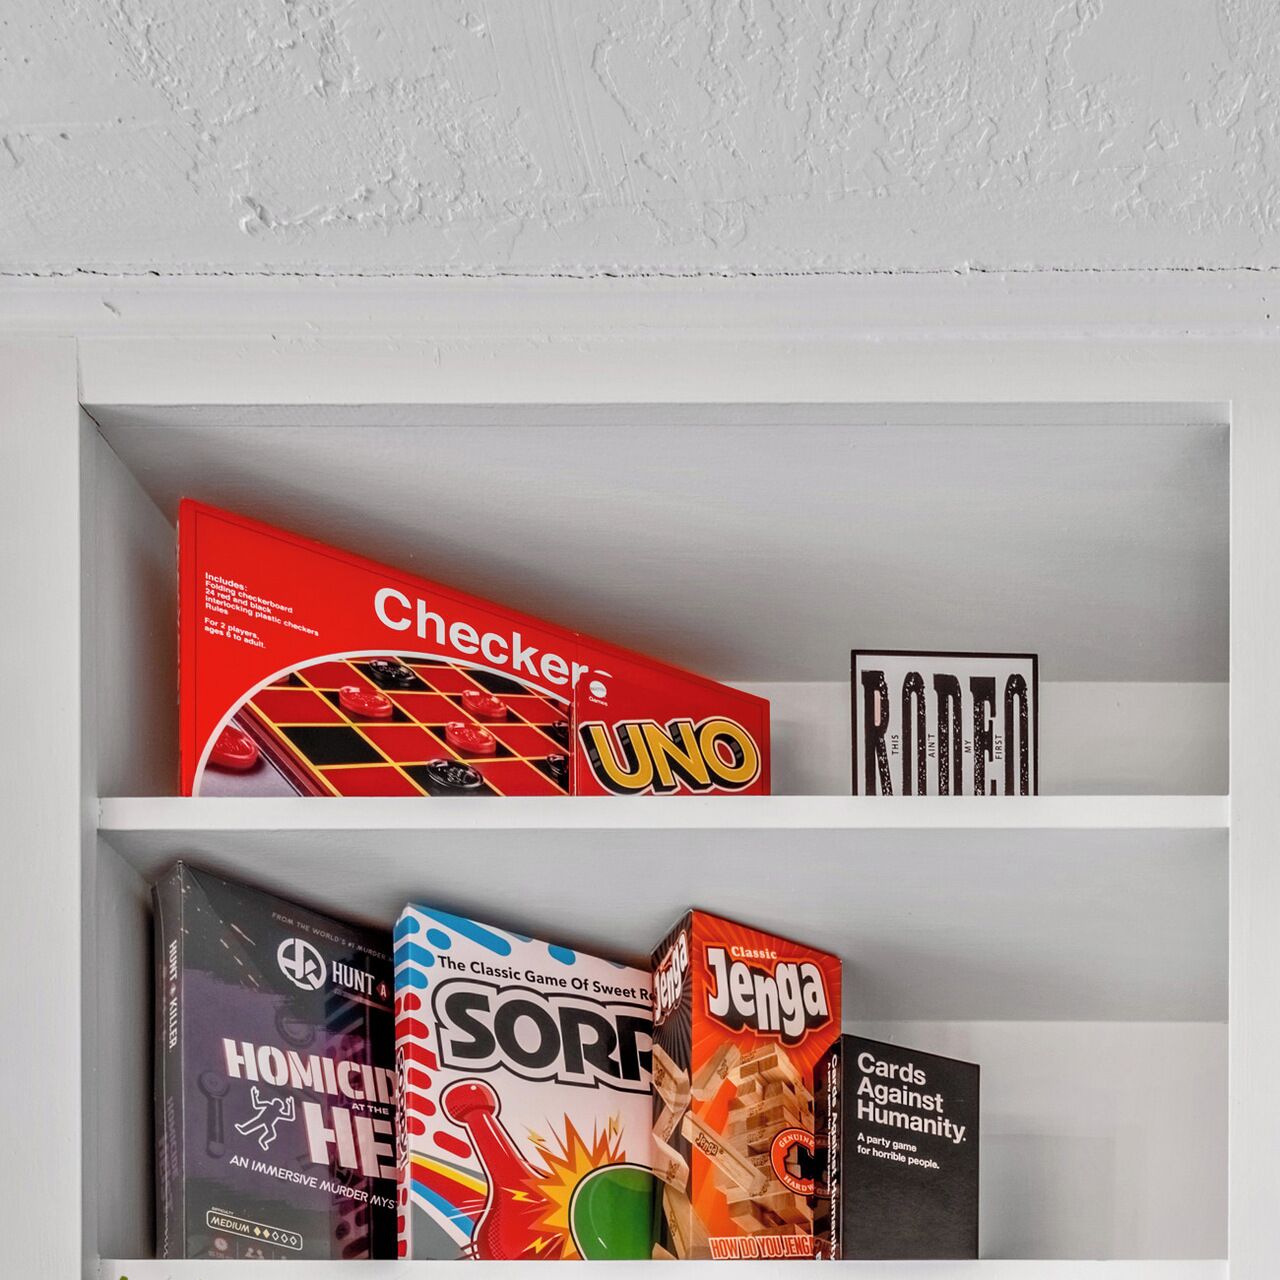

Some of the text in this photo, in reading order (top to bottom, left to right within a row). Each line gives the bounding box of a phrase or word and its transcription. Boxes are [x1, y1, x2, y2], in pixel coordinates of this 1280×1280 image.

[205, 571, 248, 592] Includes:
[205, 580, 293, 614] Folding checkerboard
[205, 587, 272, 614] 24 red and black
[205, 602, 229, 615] Rules
[205, 595, 319, 637] interlocking plastic checkers
[204, 617, 219, 627] For
[204, 625, 224, 636] ages
[233, 633, 242, 641] to
[374, 586, 613, 689] Checker
[861, 669, 1029, 796] RODEO
[891, 733, 1003, 760] THIS AIN'T MY FIRST
[580, 717, 760, 795] UNO
[271, 912, 294, 926] FROM
[296, 922, 311, 932] THE
[356, 945, 386, 960] MURDER
[731, 946, 777, 960] Classic
[169, 939, 178, 982] HUNT
[437, 955, 466, 971] The
[470, 961, 522, 981] Classic
[525, 970, 567, 988] Game
[571, 977, 590, 992] Of
[593, 981, 637, 999] Sweet
[654, 933, 689, 1021] Jenga
[331, 960, 375, 996] HUNT
[706, 947, 828, 1037] Jenga
[168, 997, 178, 1050] KILLER
[857, 1052, 927, 1086] Cards
[351, 1103, 389, 1116] AT THE
[857, 1076, 944, 1114] Against
[857, 1101, 967, 1144] Humanity.
[695, 1132, 719, 1156] Jenga
[778, 1133, 815, 1148] GENUINE
[857, 1132, 917, 1153] A party game
[857, 1144, 940, 1170] for horrible people.
[229, 1155, 398, 1210] AN IMMERSIVE MURDER MYS
[210, 1216, 250, 1233] MEDIUM
[711, 1237, 738, 1258] HOW
[740, 1237, 758, 1258] DO
[758, 1236, 782, 1258] YOU
